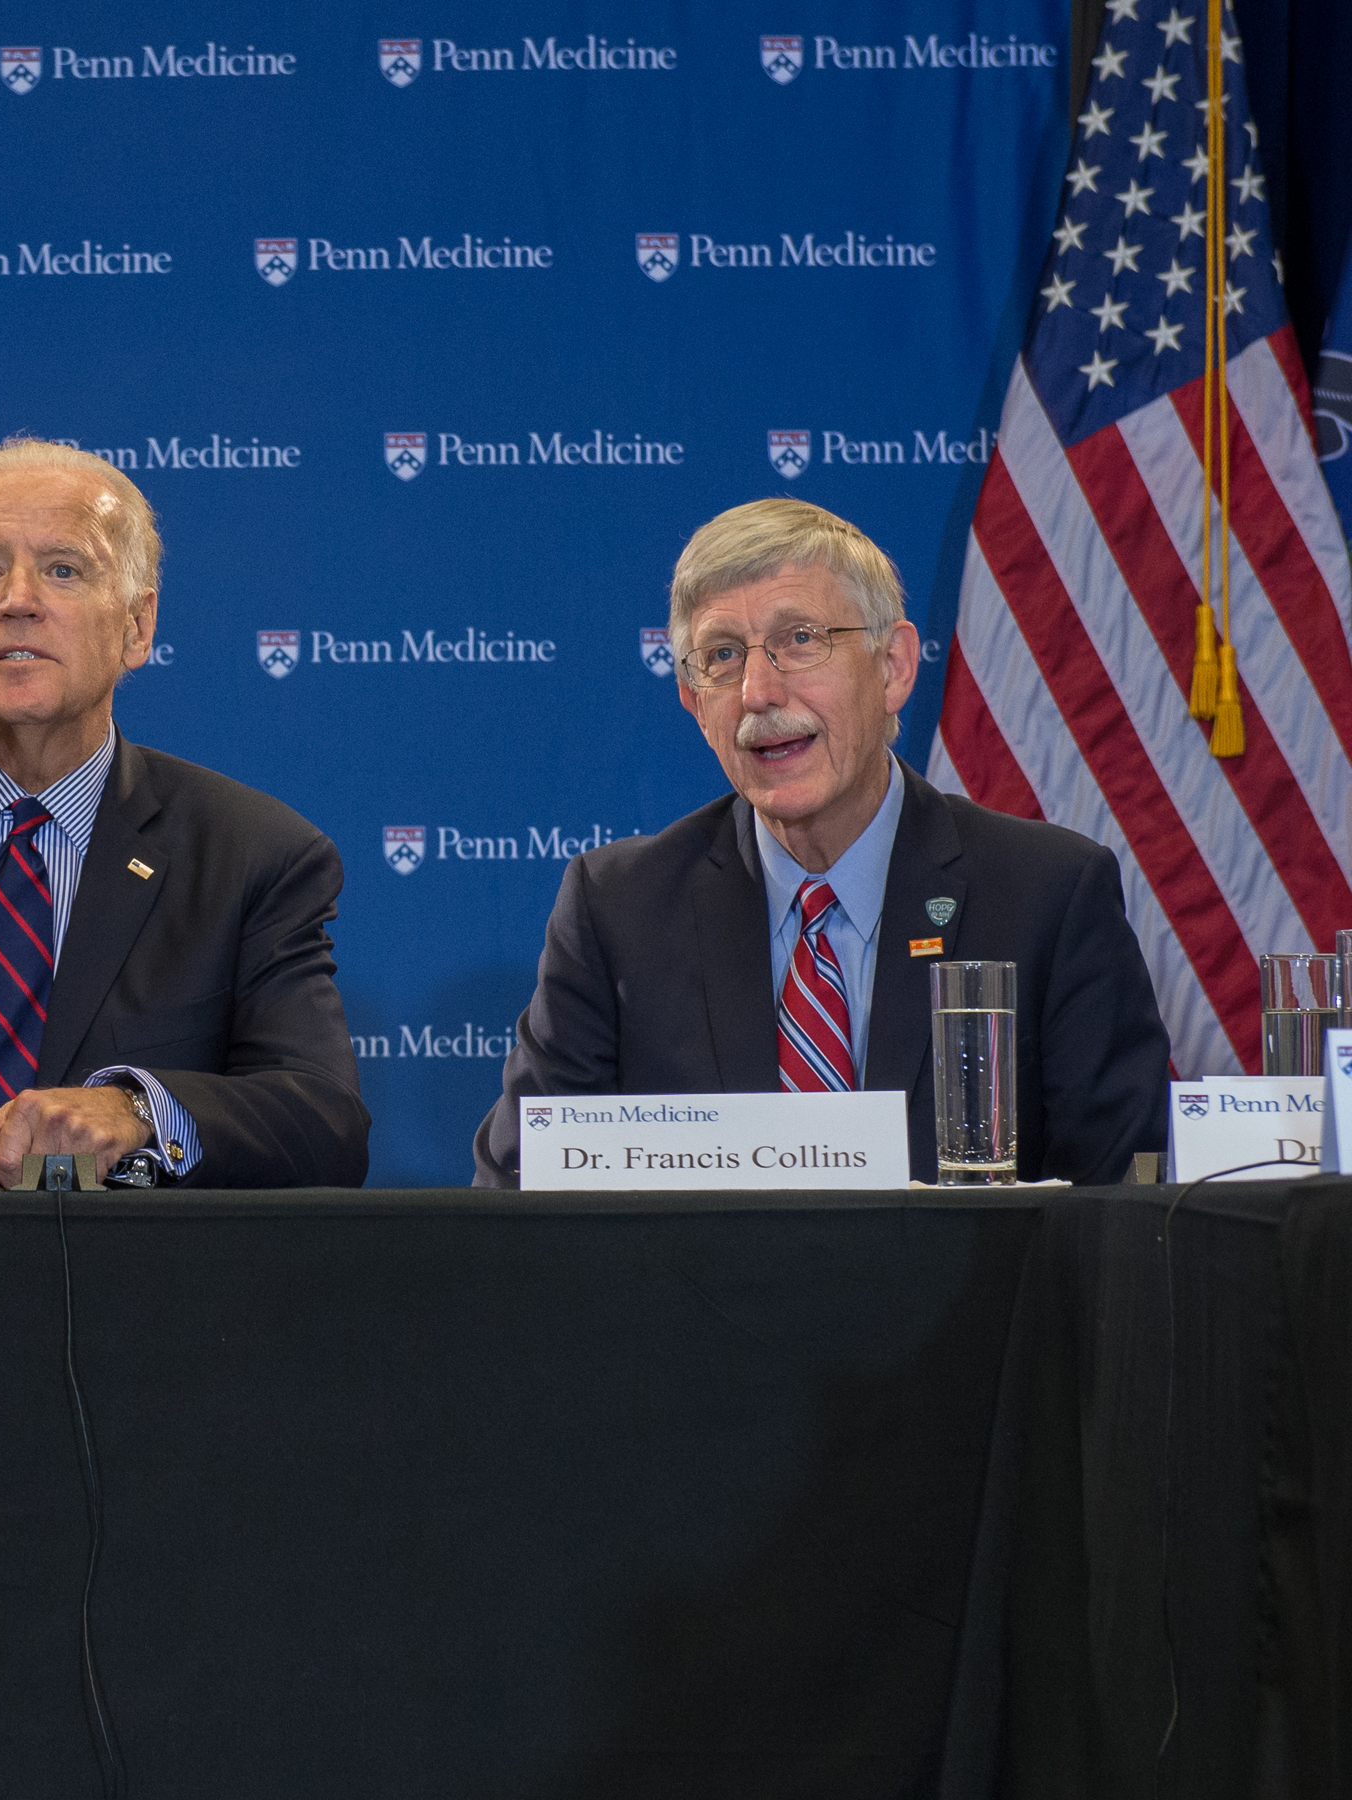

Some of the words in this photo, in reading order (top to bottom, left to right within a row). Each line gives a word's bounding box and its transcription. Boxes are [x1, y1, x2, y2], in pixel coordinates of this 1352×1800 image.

[53, 46, 134, 79] Penn
[141, 42, 296, 78] Medicine
[432, 39, 515, 72] Penn
[522, 34, 677, 70] Medicine
[814, 35, 896, 69] Penn
[903, 32, 1058, 68] Medicine
[17, 240, 172, 276] Medicine
[308, 238, 391, 271] Penn
[397, 233, 553, 270] Medicine
[690, 234, 773, 268] Penn
[780, 230, 936, 267] Medicine
[145, 433, 301, 470] Medicine
[438, 432, 520, 466] Penn
[528, 429, 684, 465] Medicine
[822, 430, 905, 464] Penn
[311, 630, 393, 664] Penn
[400, 626, 556, 663] Medicine
[437, 826, 518, 860] Penn
[399, 1022, 516, 1059] Medici
[560, 1106, 614, 1124] Penn
[618, 1103, 720, 1123] Medicine
[1218, 1093, 1282, 1113] Penn
[561, 1147, 611, 1170] Dr.
[623, 1145, 741, 1170] Francis
[751, 1144, 868, 1169] Collins
